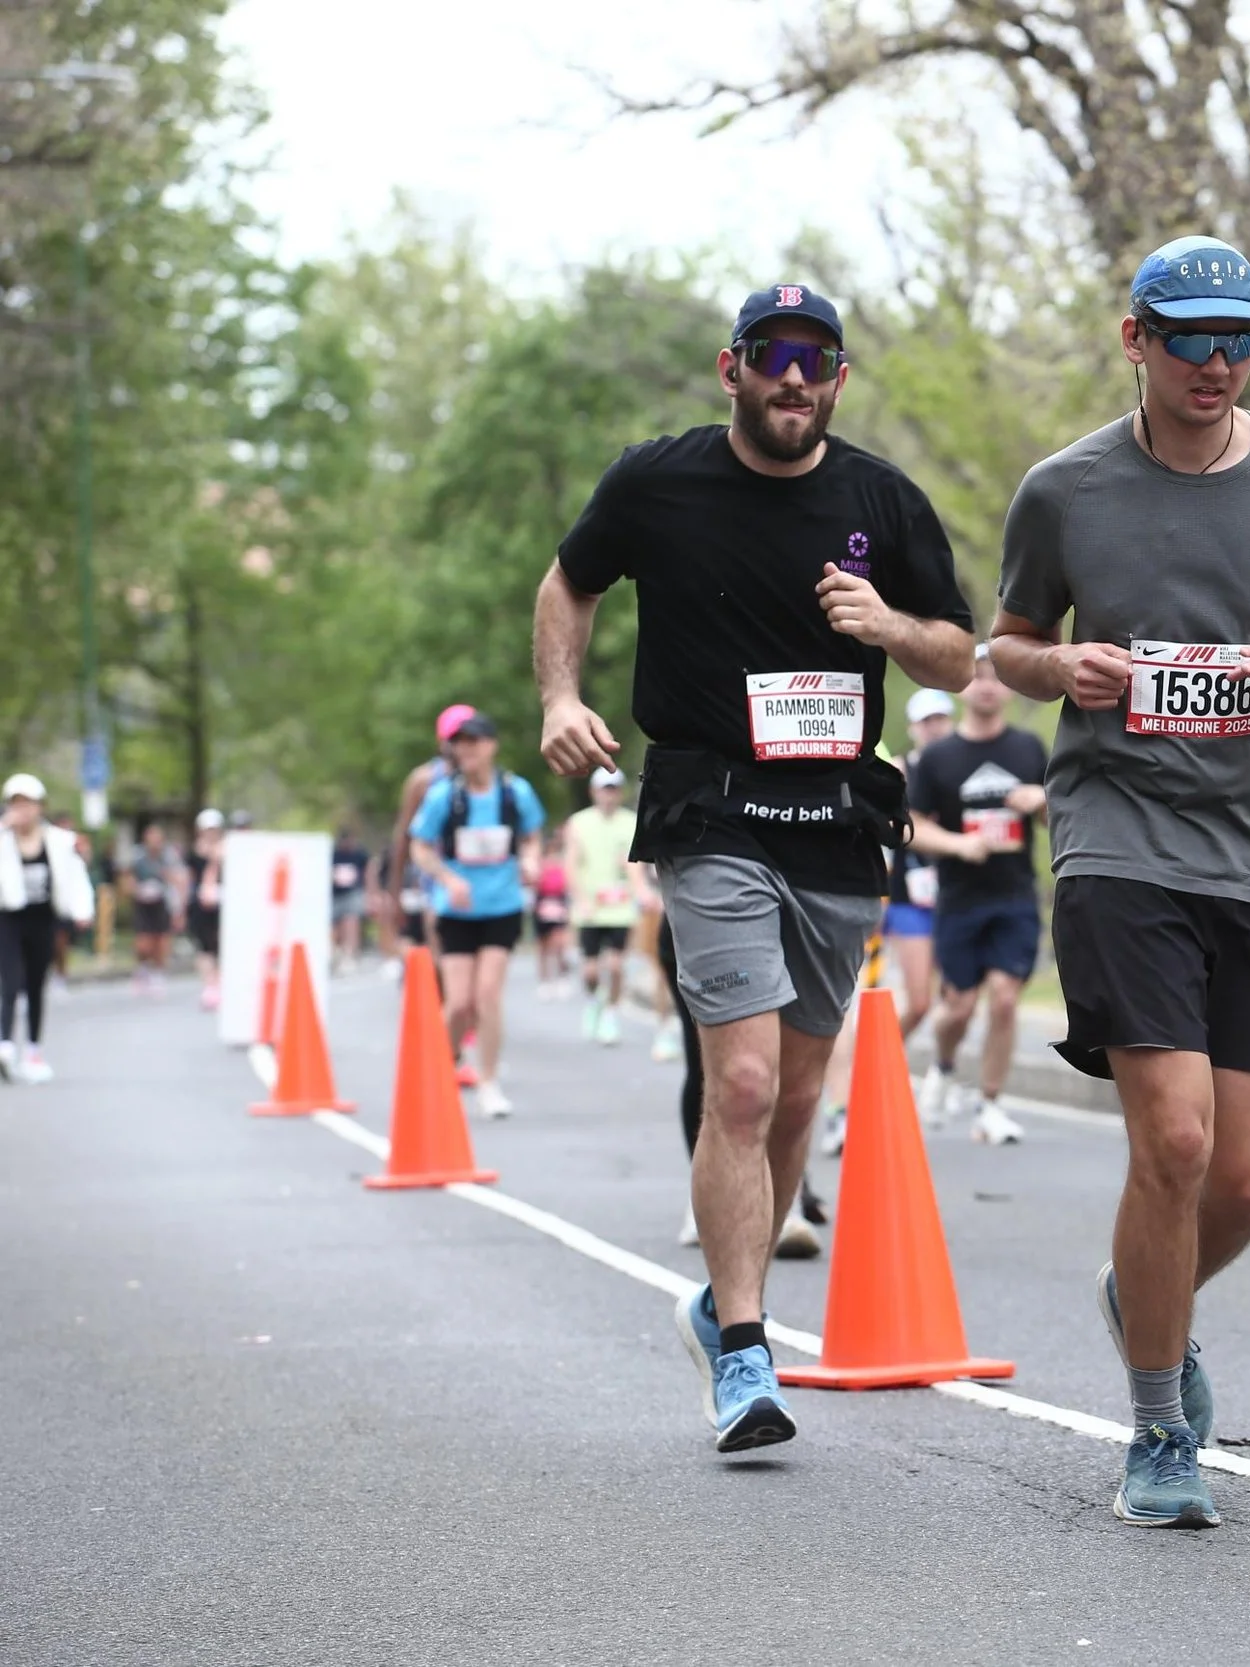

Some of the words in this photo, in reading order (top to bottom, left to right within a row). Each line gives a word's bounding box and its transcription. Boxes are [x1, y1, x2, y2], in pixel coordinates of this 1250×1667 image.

[775, 286, 803, 307] B
[840, 559, 871, 571] MIXED
[765, 698, 825, 717] RAMMBO
[829, 698, 855, 717] RUNS
[797, 720, 835, 737] 10994
[1141, 717, 1221, 734] MELBOURNE
[765, 742, 833, 757] MELBOURNE
[835, 743, 856, 756] 2025
[743, 802, 793, 822] nerd
[798, 805, 834, 822] belt
